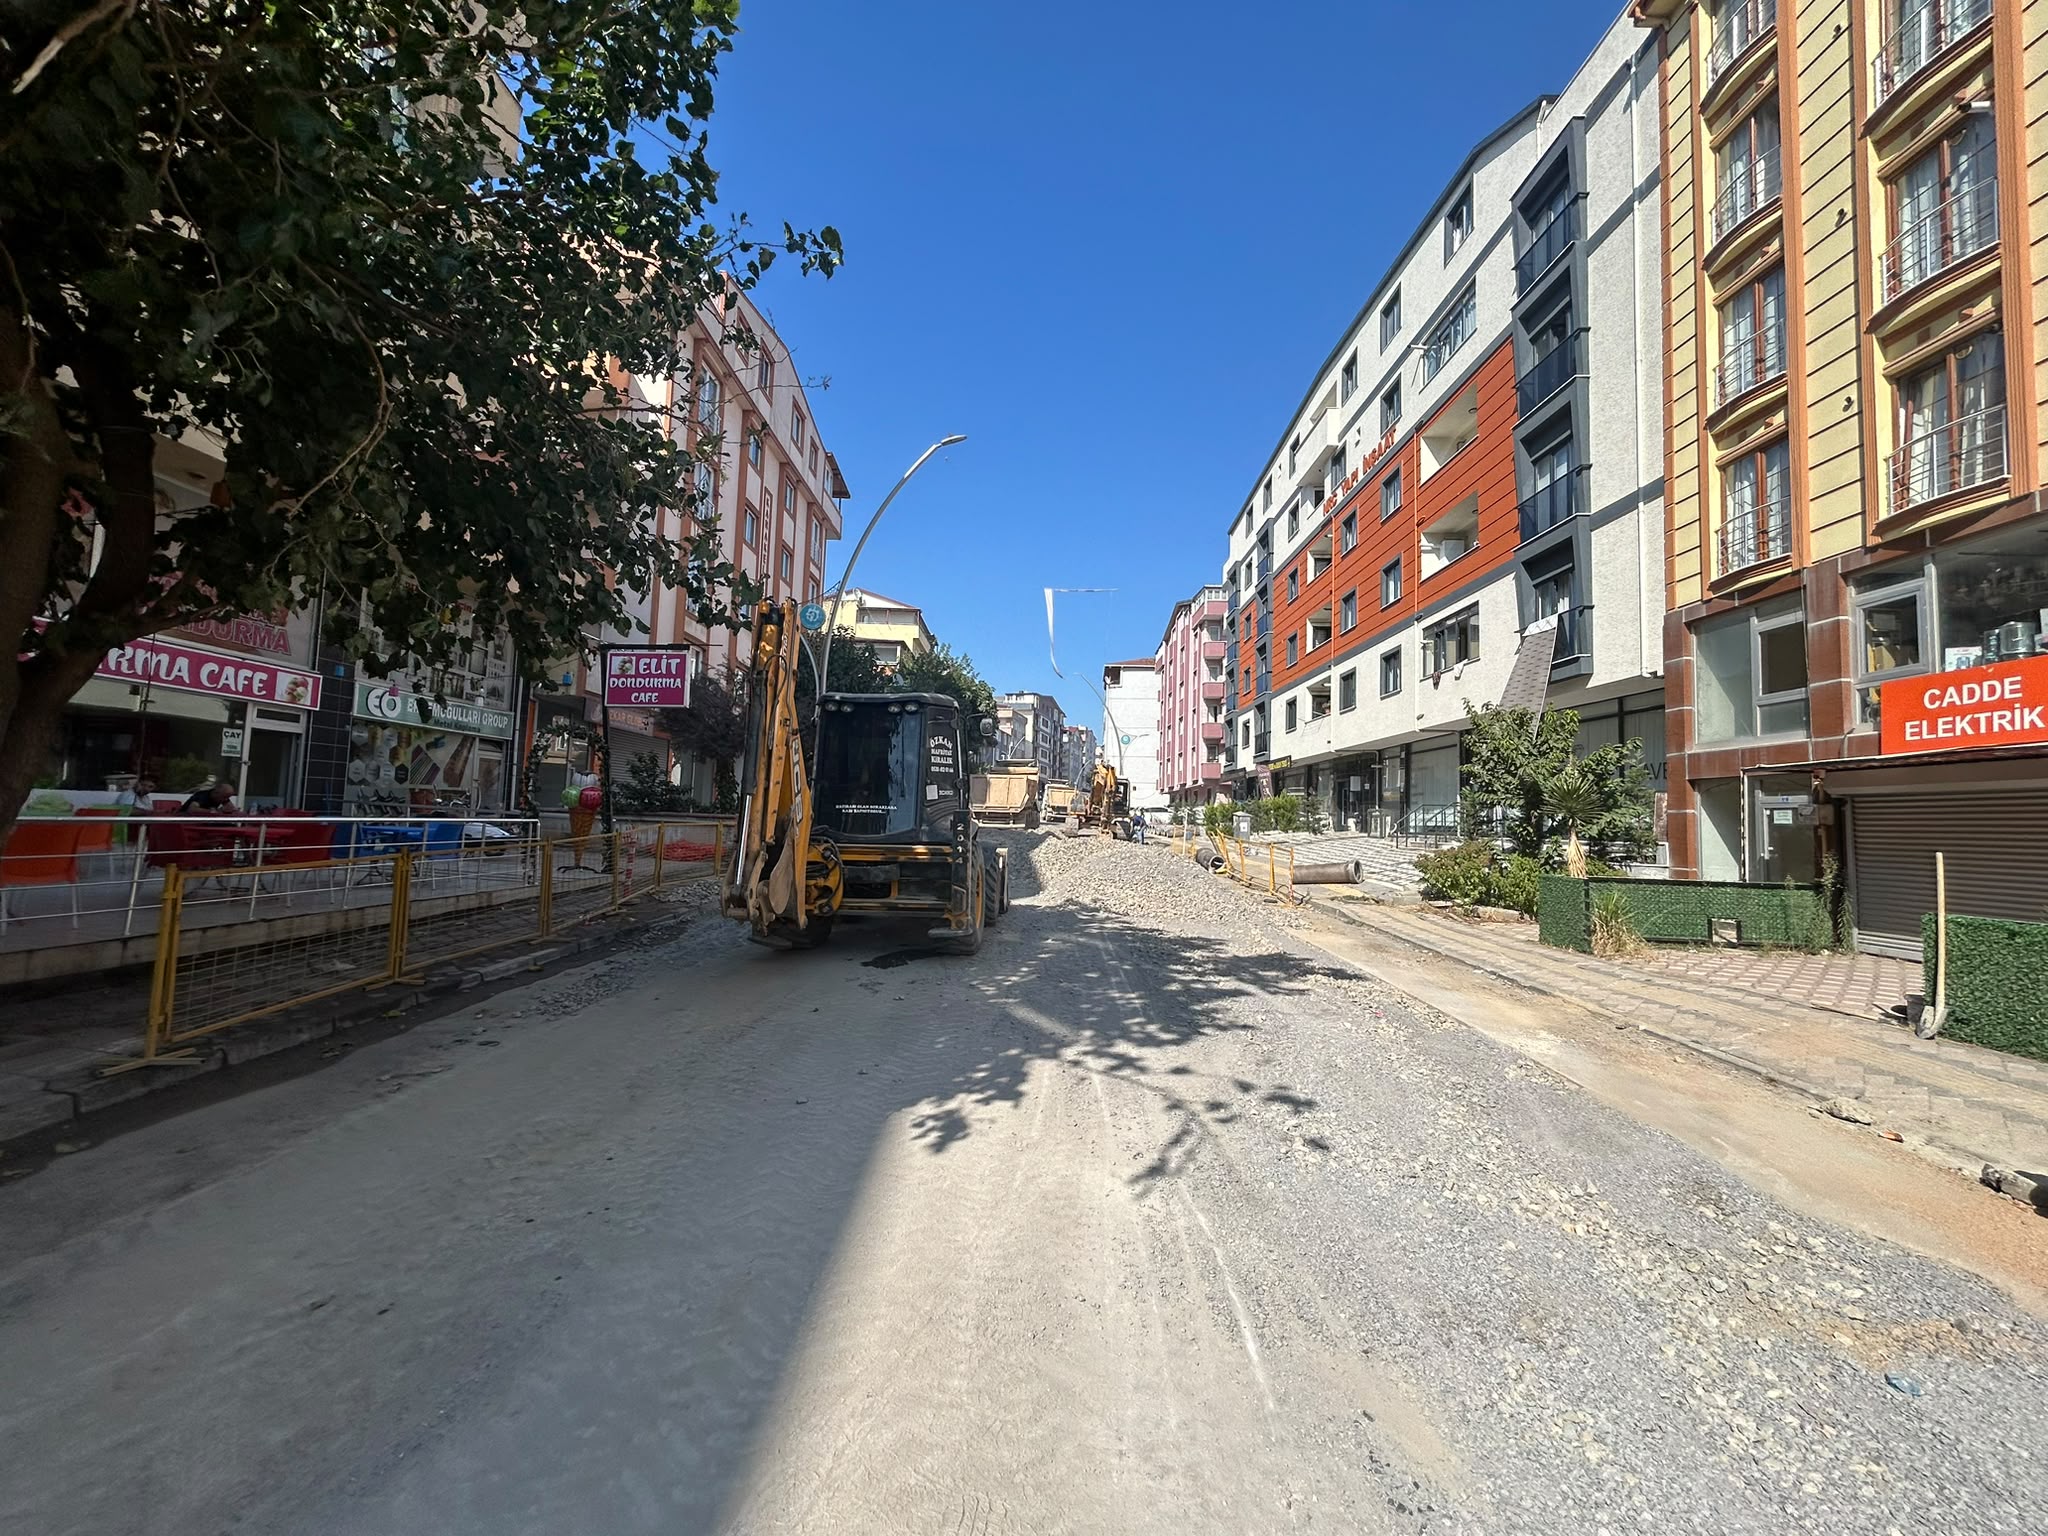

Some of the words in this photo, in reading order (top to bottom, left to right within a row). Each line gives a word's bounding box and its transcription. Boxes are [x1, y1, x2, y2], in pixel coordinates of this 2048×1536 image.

[638, 654, 681, 675] ELİT
[199, 661, 269, 696] CAFE
[609, 677, 682, 689] DONDURMA
[631, 692, 659, 704] CAFE
[1923, 676, 2022, 709] CADDE
[483, 712, 509, 729] GROUP
[1905, 704, 2045, 741] ELEKTRİK
[930, 736, 953, 749] ÖZKAN
